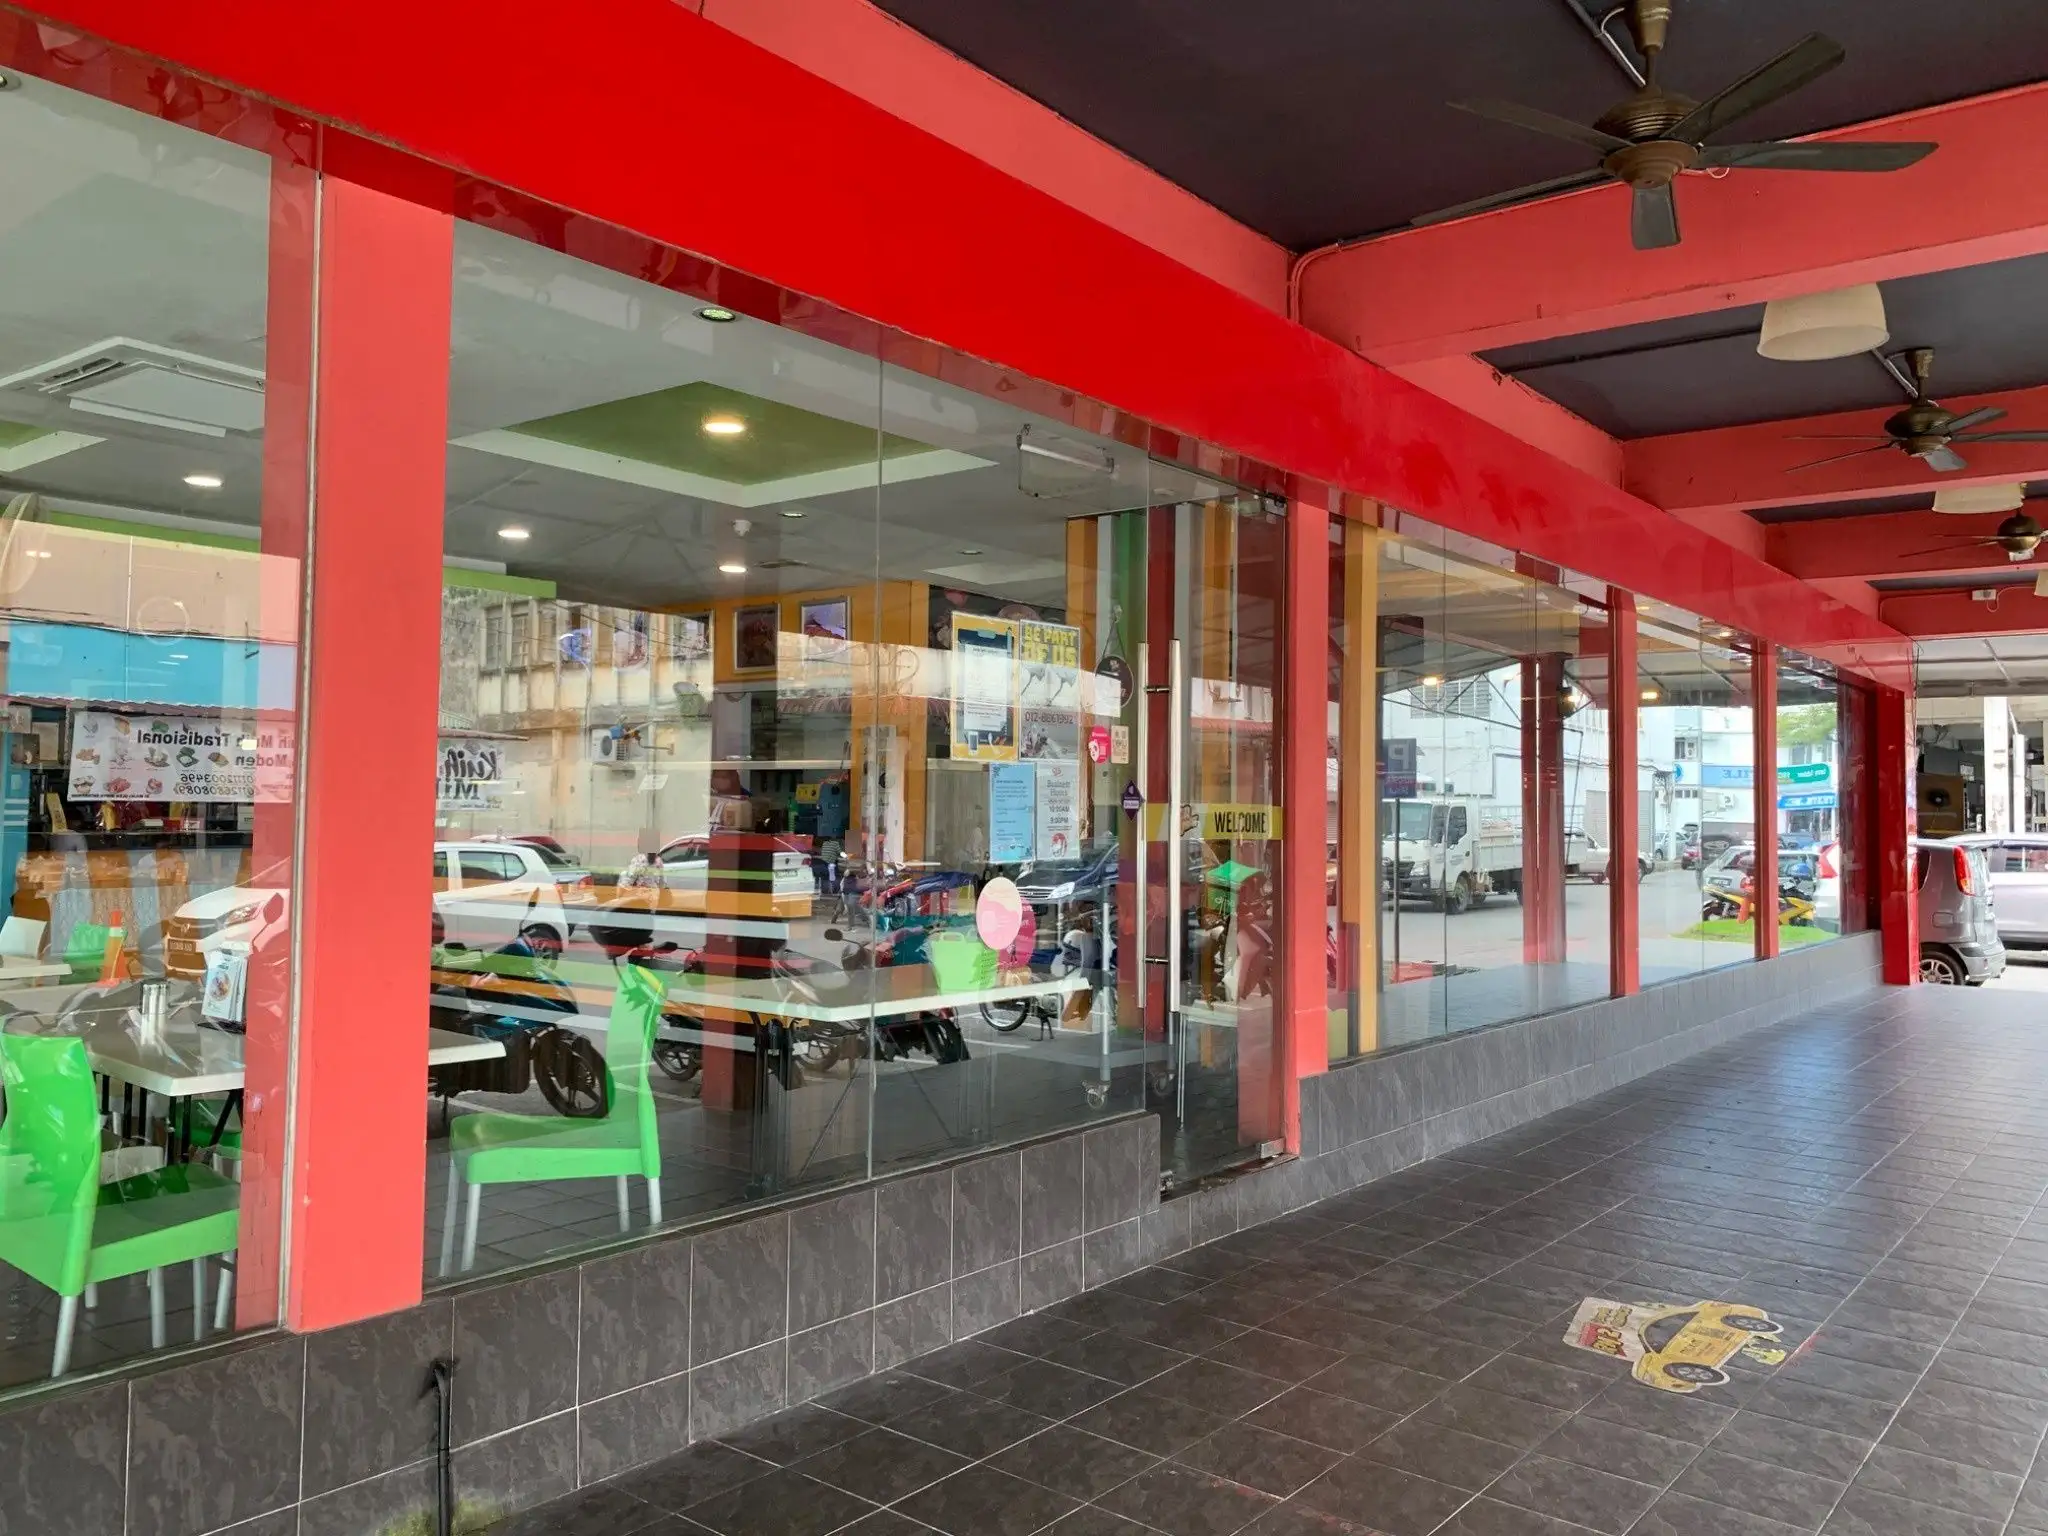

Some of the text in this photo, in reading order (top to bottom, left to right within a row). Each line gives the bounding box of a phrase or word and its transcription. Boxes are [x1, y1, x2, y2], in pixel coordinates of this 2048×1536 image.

[1025, 624, 1077, 647] BE PART
[1023, 641, 1077, 667] OF US
[1214, 811, 1267, 833] WELCOME
